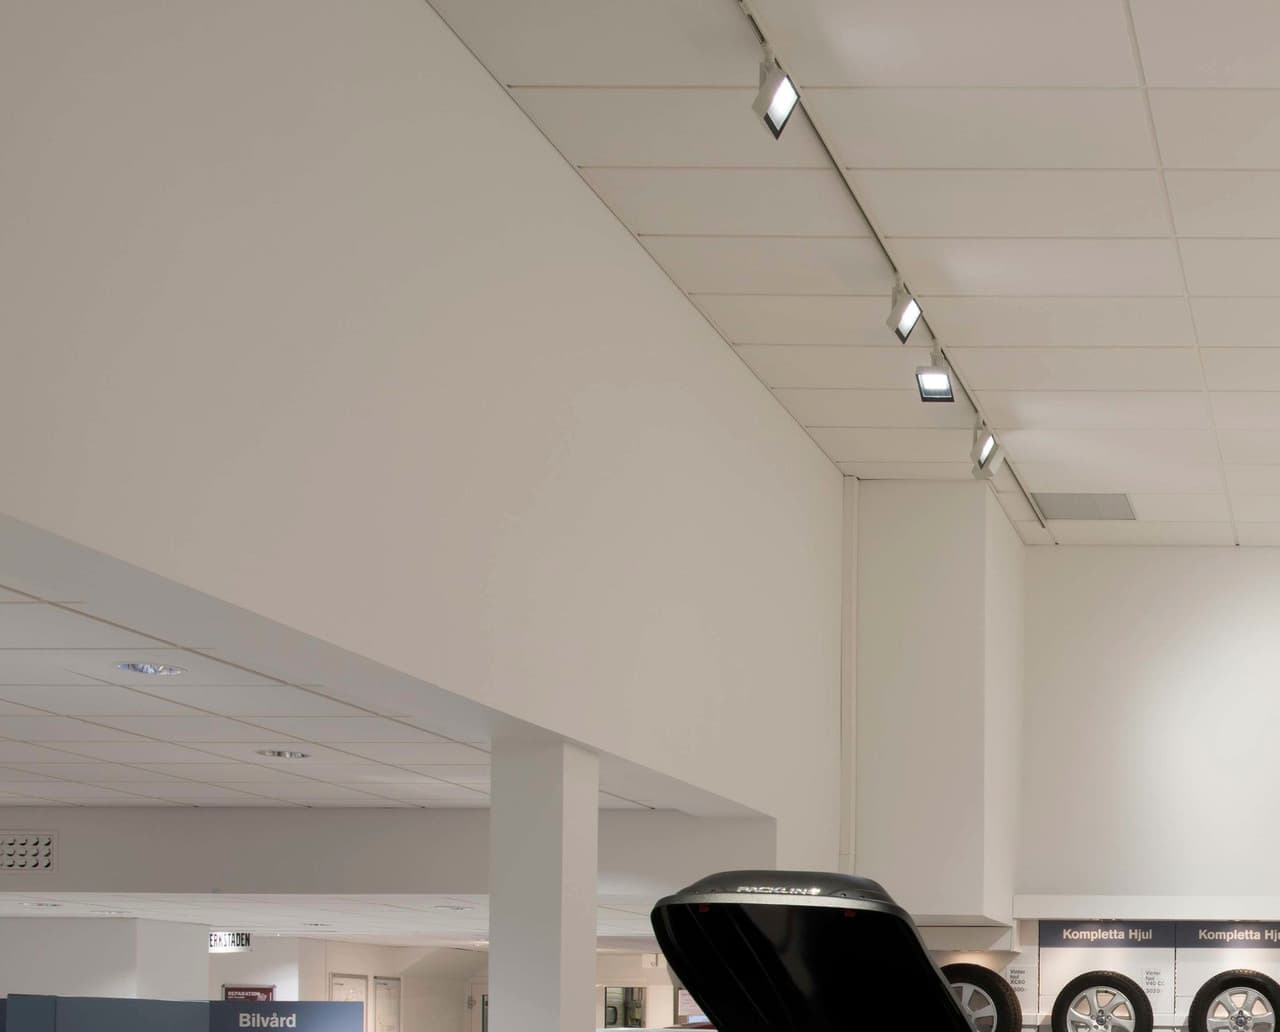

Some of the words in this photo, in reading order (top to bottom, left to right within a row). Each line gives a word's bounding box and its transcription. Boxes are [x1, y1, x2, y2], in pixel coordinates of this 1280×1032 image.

[1062, 928, 1125, 942] Kompletta
[1128, 929, 1153, 943] Hjul
[1198, 929, 1261, 943] Kompletta
[239, 1012, 297, 1028] Bilvård
